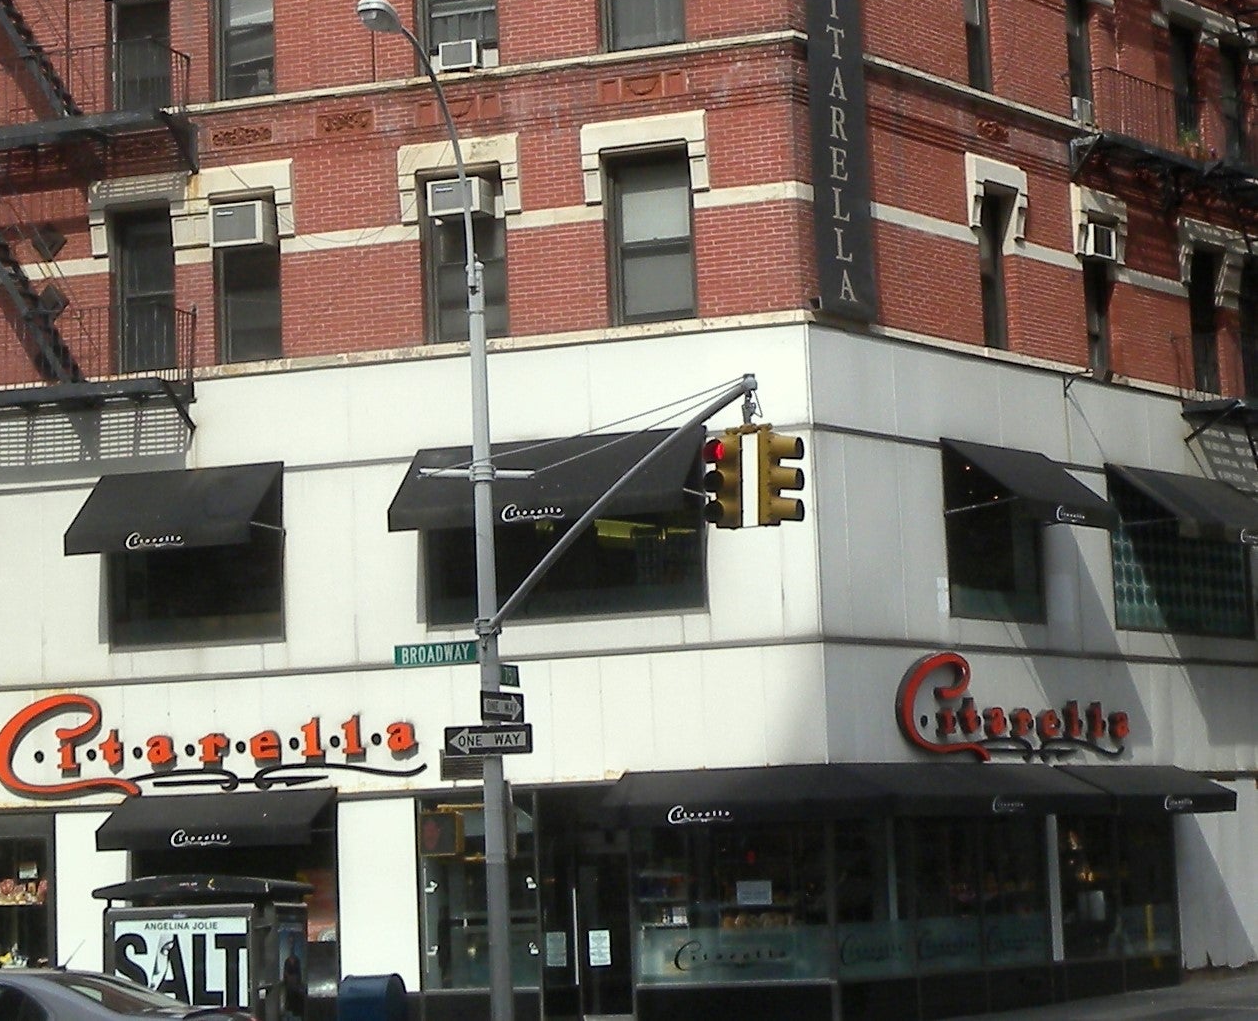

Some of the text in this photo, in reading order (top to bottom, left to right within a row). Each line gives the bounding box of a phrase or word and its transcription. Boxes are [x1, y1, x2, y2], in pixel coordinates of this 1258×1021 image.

[402, 643, 470, 664] BROADWAY
[895, 652, 1130, 762] Citarella
[458, 733, 521, 747] ONE WAY
[144, 921, 218, 930] ANGELINA JOLIE
[114, 933, 248, 1008] SALT
